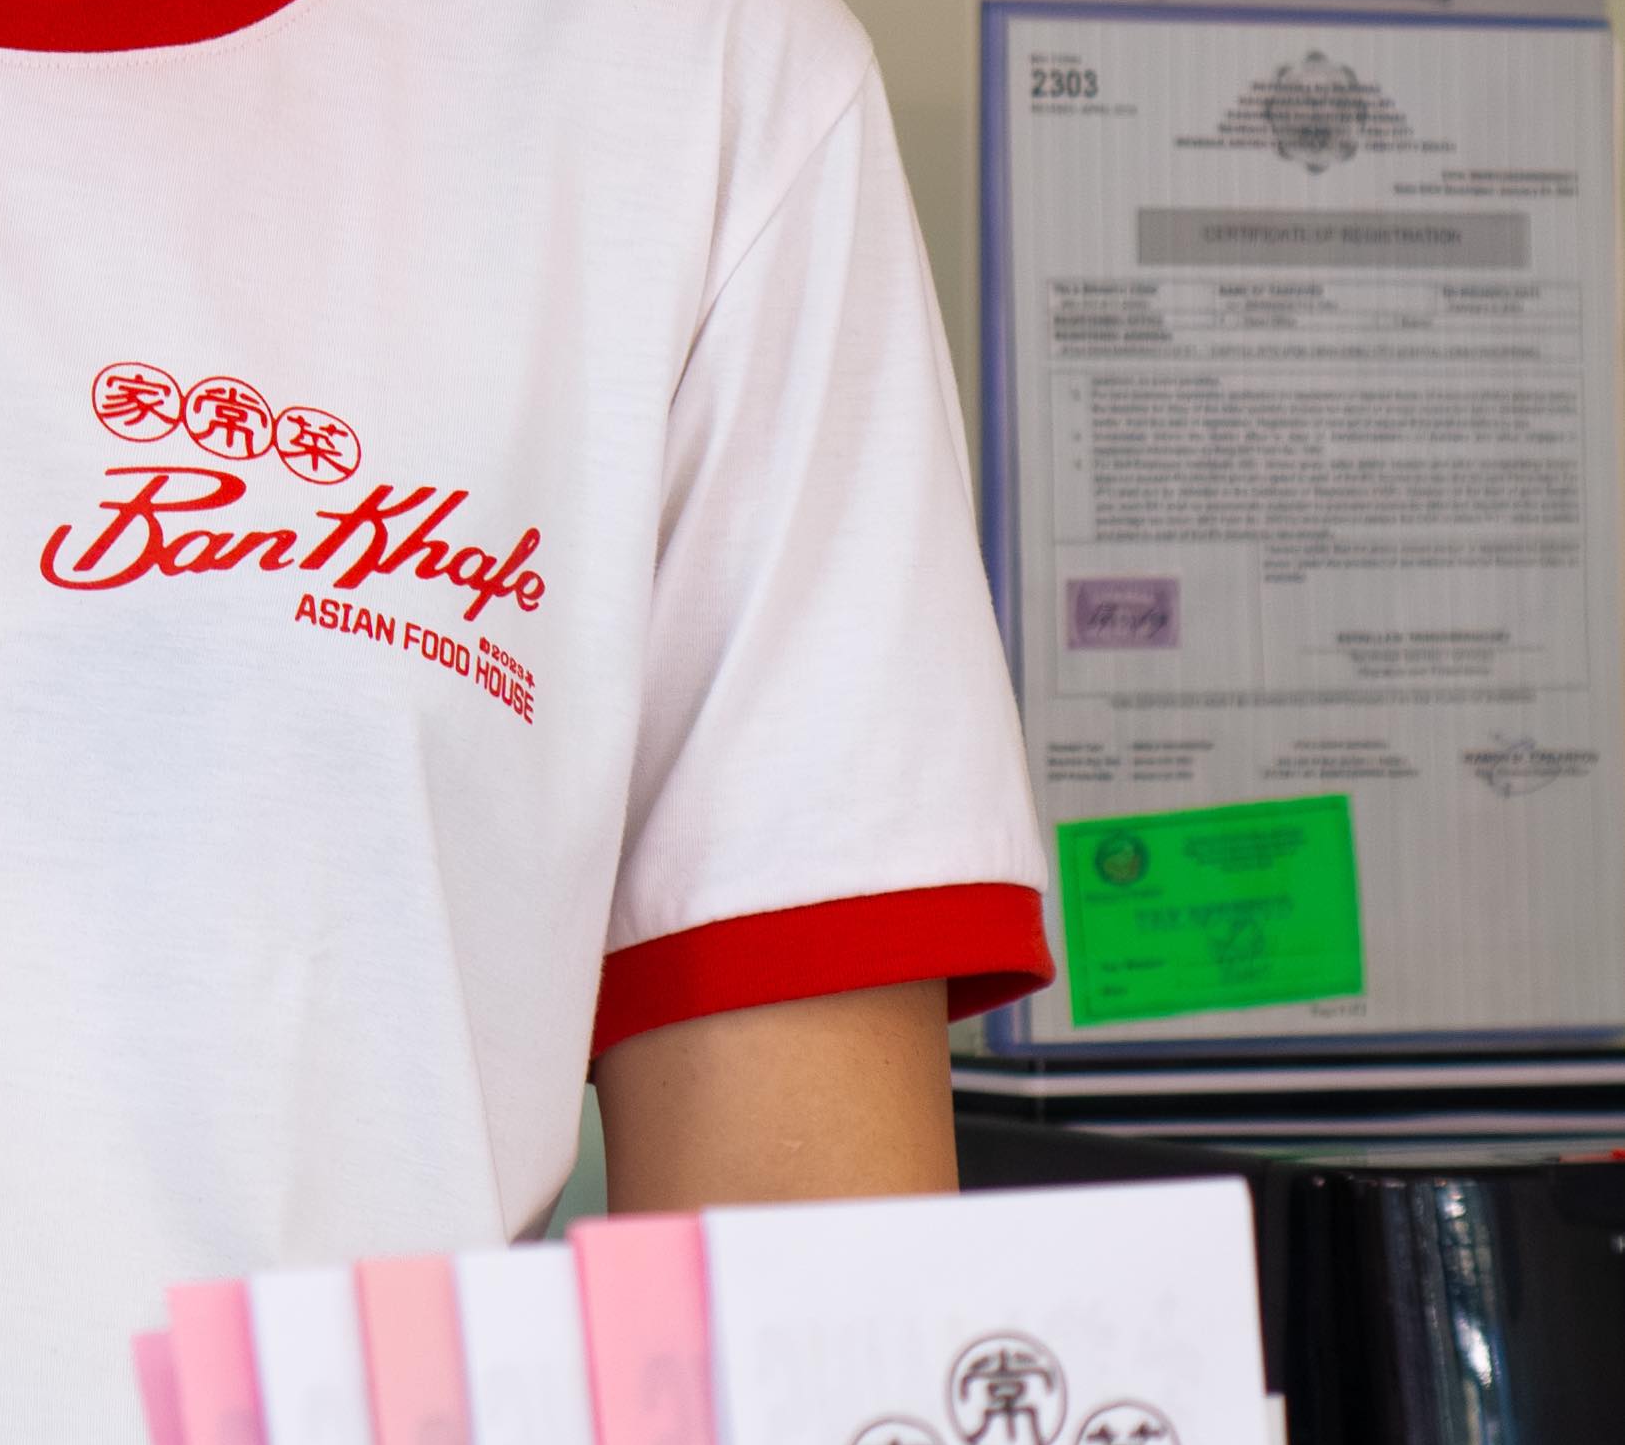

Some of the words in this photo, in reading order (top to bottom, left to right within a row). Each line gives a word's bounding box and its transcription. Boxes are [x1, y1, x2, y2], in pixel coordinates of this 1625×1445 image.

[1031, 68, 1099, 98] 2303
[95, 367, 357, 479] 家常菜
[294, 593, 396, 646] ASIAN
[402, 621, 471, 677] FOOD
[474, 656, 534, 725] HOUSE
